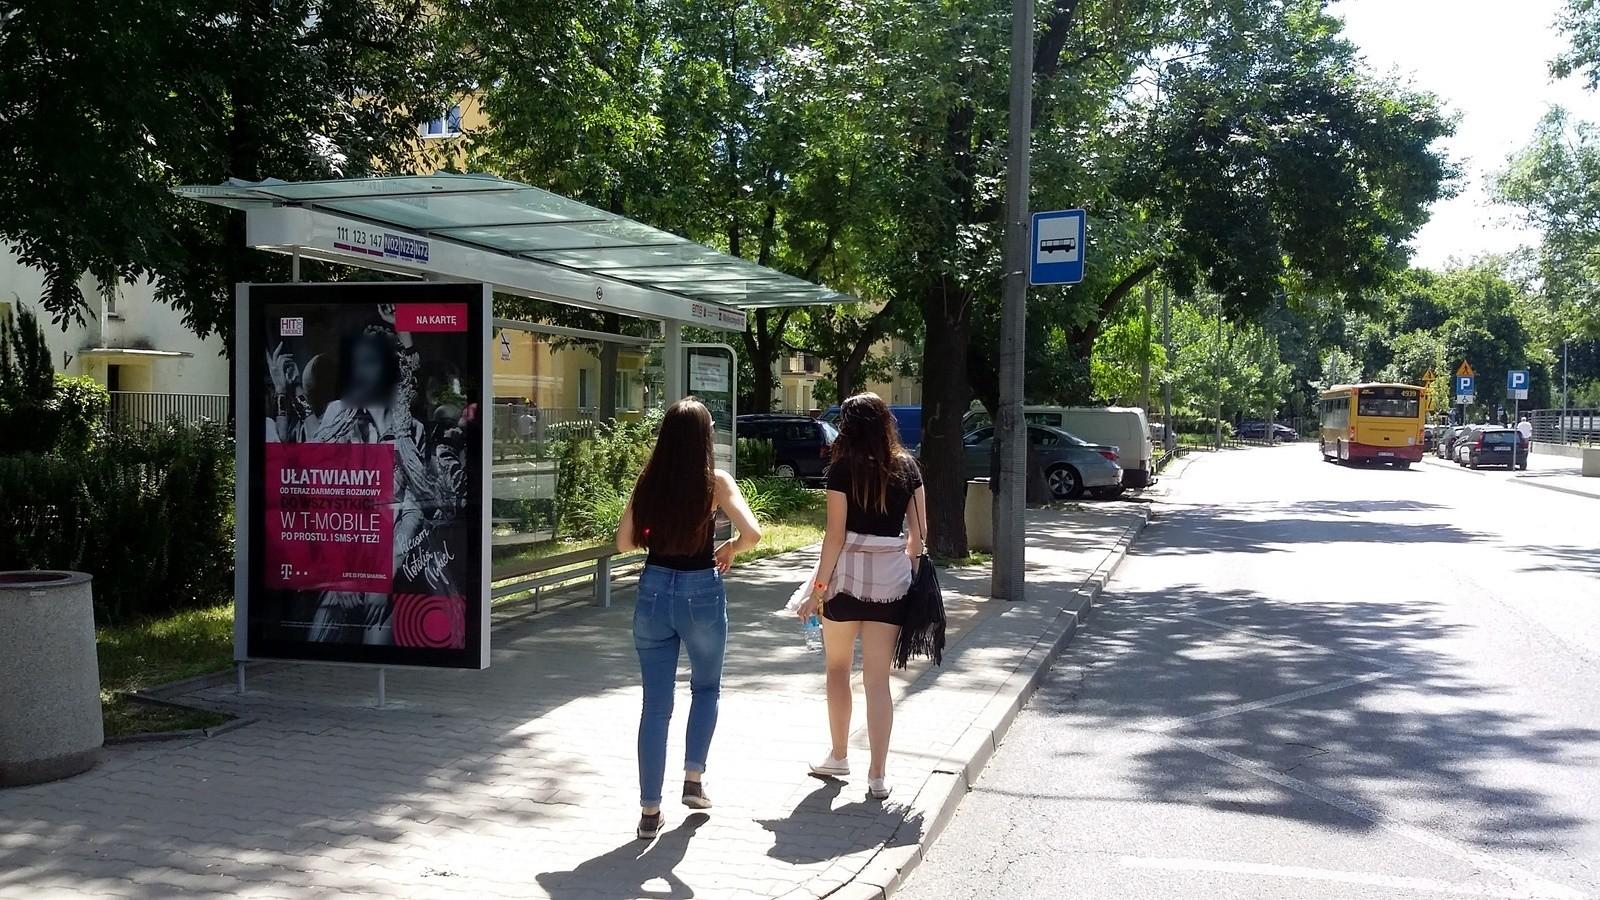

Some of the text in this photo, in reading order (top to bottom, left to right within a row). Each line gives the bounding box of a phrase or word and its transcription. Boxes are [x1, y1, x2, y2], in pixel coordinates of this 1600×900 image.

[337, 226, 428, 258] 111 123 147 N02 N22 N72
[281, 319, 296, 329] HIT
[416, 316, 457, 326] NA KARTĘ
[1460, 377, 1471, 390] P
[1512, 373, 1525, 388] P
[280, 468, 381, 486] UŁATWIAMY!
[280, 487, 381, 496] OD TERAZ DARMOWE ROZMOWY
[280, 511, 380, 532] W T-MOBILE
[281, 532, 293, 541] PO
[294, 532, 329, 542] PROSTU.
[335, 534, 360, 543] SMS-Y
[361, 532, 380, 544] TEŻ!
